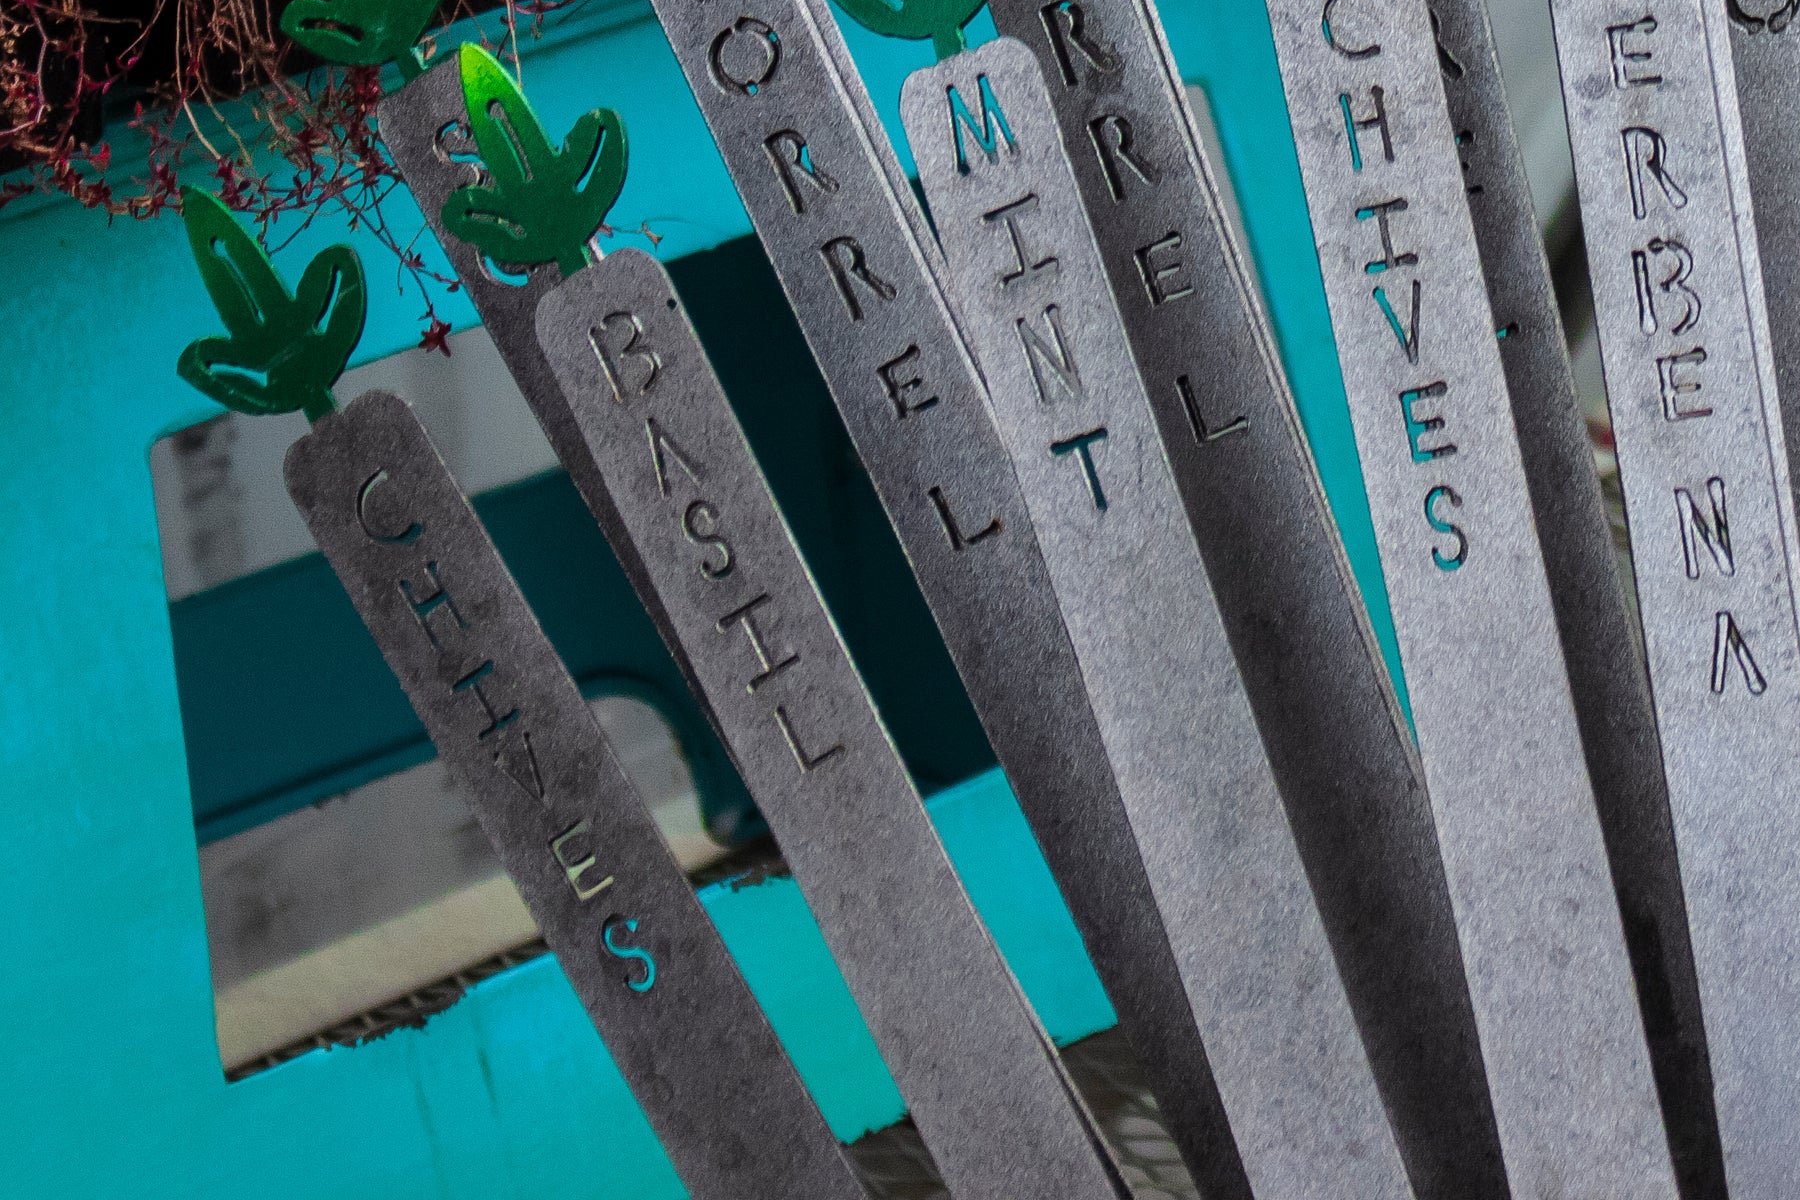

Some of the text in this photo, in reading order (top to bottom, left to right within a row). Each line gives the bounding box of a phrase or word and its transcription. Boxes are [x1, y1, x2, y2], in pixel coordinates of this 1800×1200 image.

[946, 73, 1109, 512] MINT
[354, 466, 657, 993] CHIVES
[587, 310, 846, 775] BASIL
